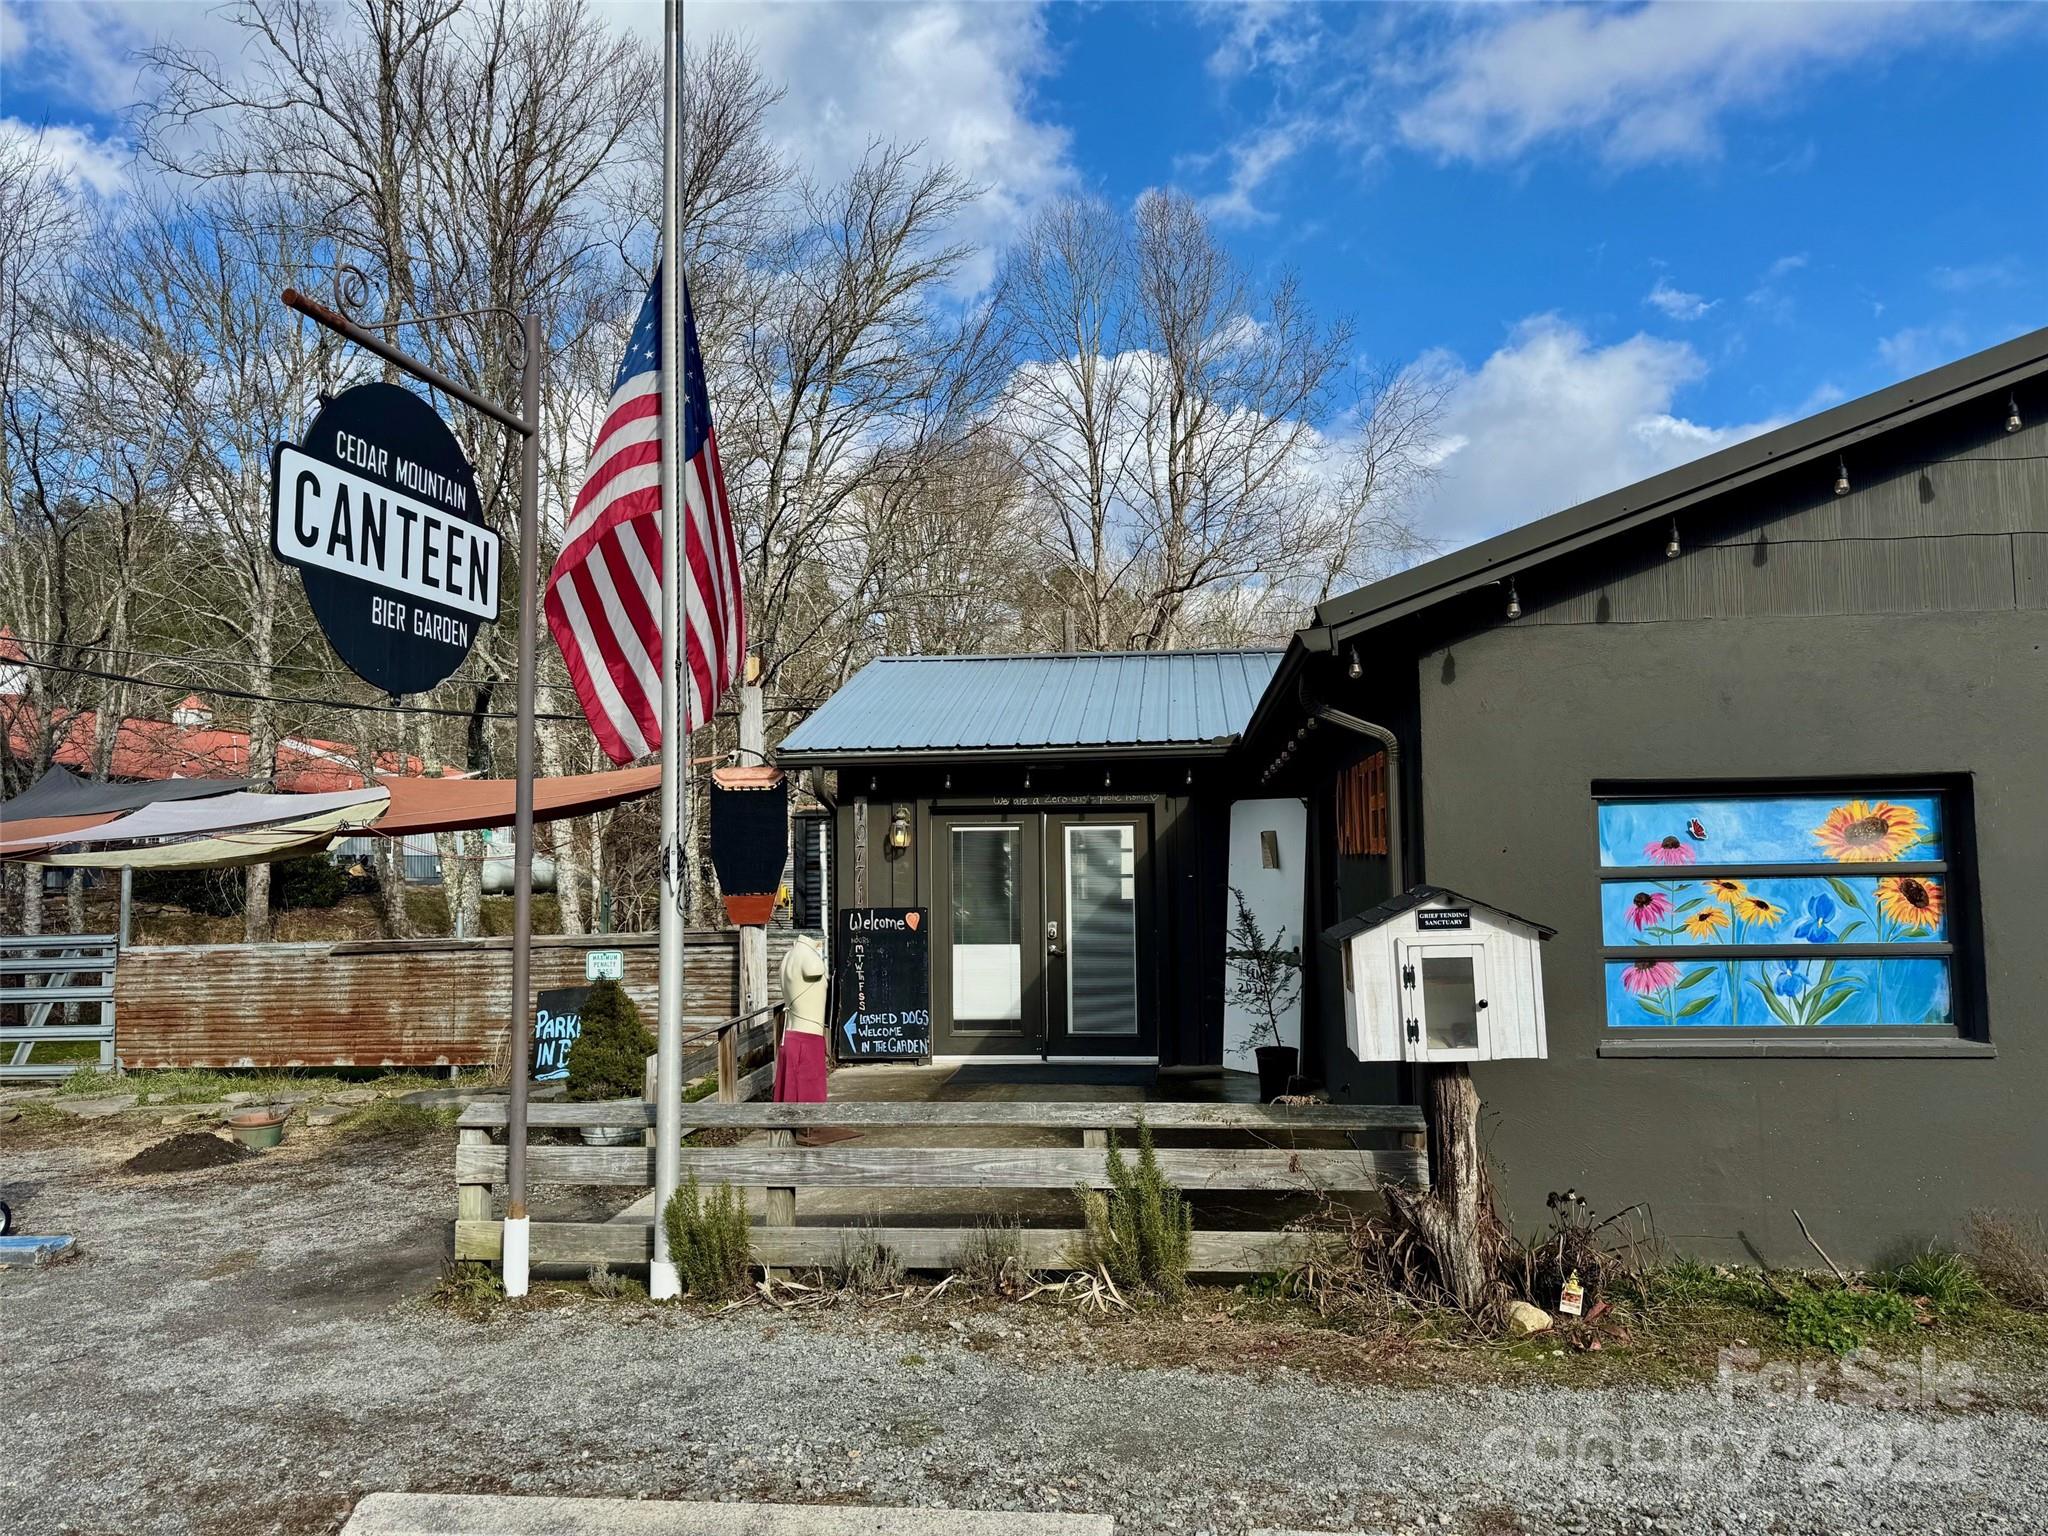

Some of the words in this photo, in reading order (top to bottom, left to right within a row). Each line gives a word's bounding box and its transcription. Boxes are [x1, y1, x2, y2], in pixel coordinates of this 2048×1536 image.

[336, 430, 388, 478] CEDAR
[395, 456, 467, 512] MOUNTAIN
[294, 470, 490, 606] CANTEEN
[371, 596, 406, 632] BIER
[413, 608, 468, 649] GARDEN
[849, 909, 905, 931] Welcome
[855, 944, 864, 953] M
[855, 954, 865, 963] T
[855, 963, 864, 971] W
[858, 982, 865, 991] F
[858, 992, 866, 1001] S
[858, 1001, 866, 1011] S
[859, 1013, 897, 1025] LEASHED
[900, 1010, 929, 1026] DOGS
[858, 1025, 903, 1037] WELCOME
[861, 1040, 870, 1053] IN
[873, 1040, 887, 1053] THE
[887, 1037, 929, 1055] GARDEN
[536, 1040, 556, 1069] IN
